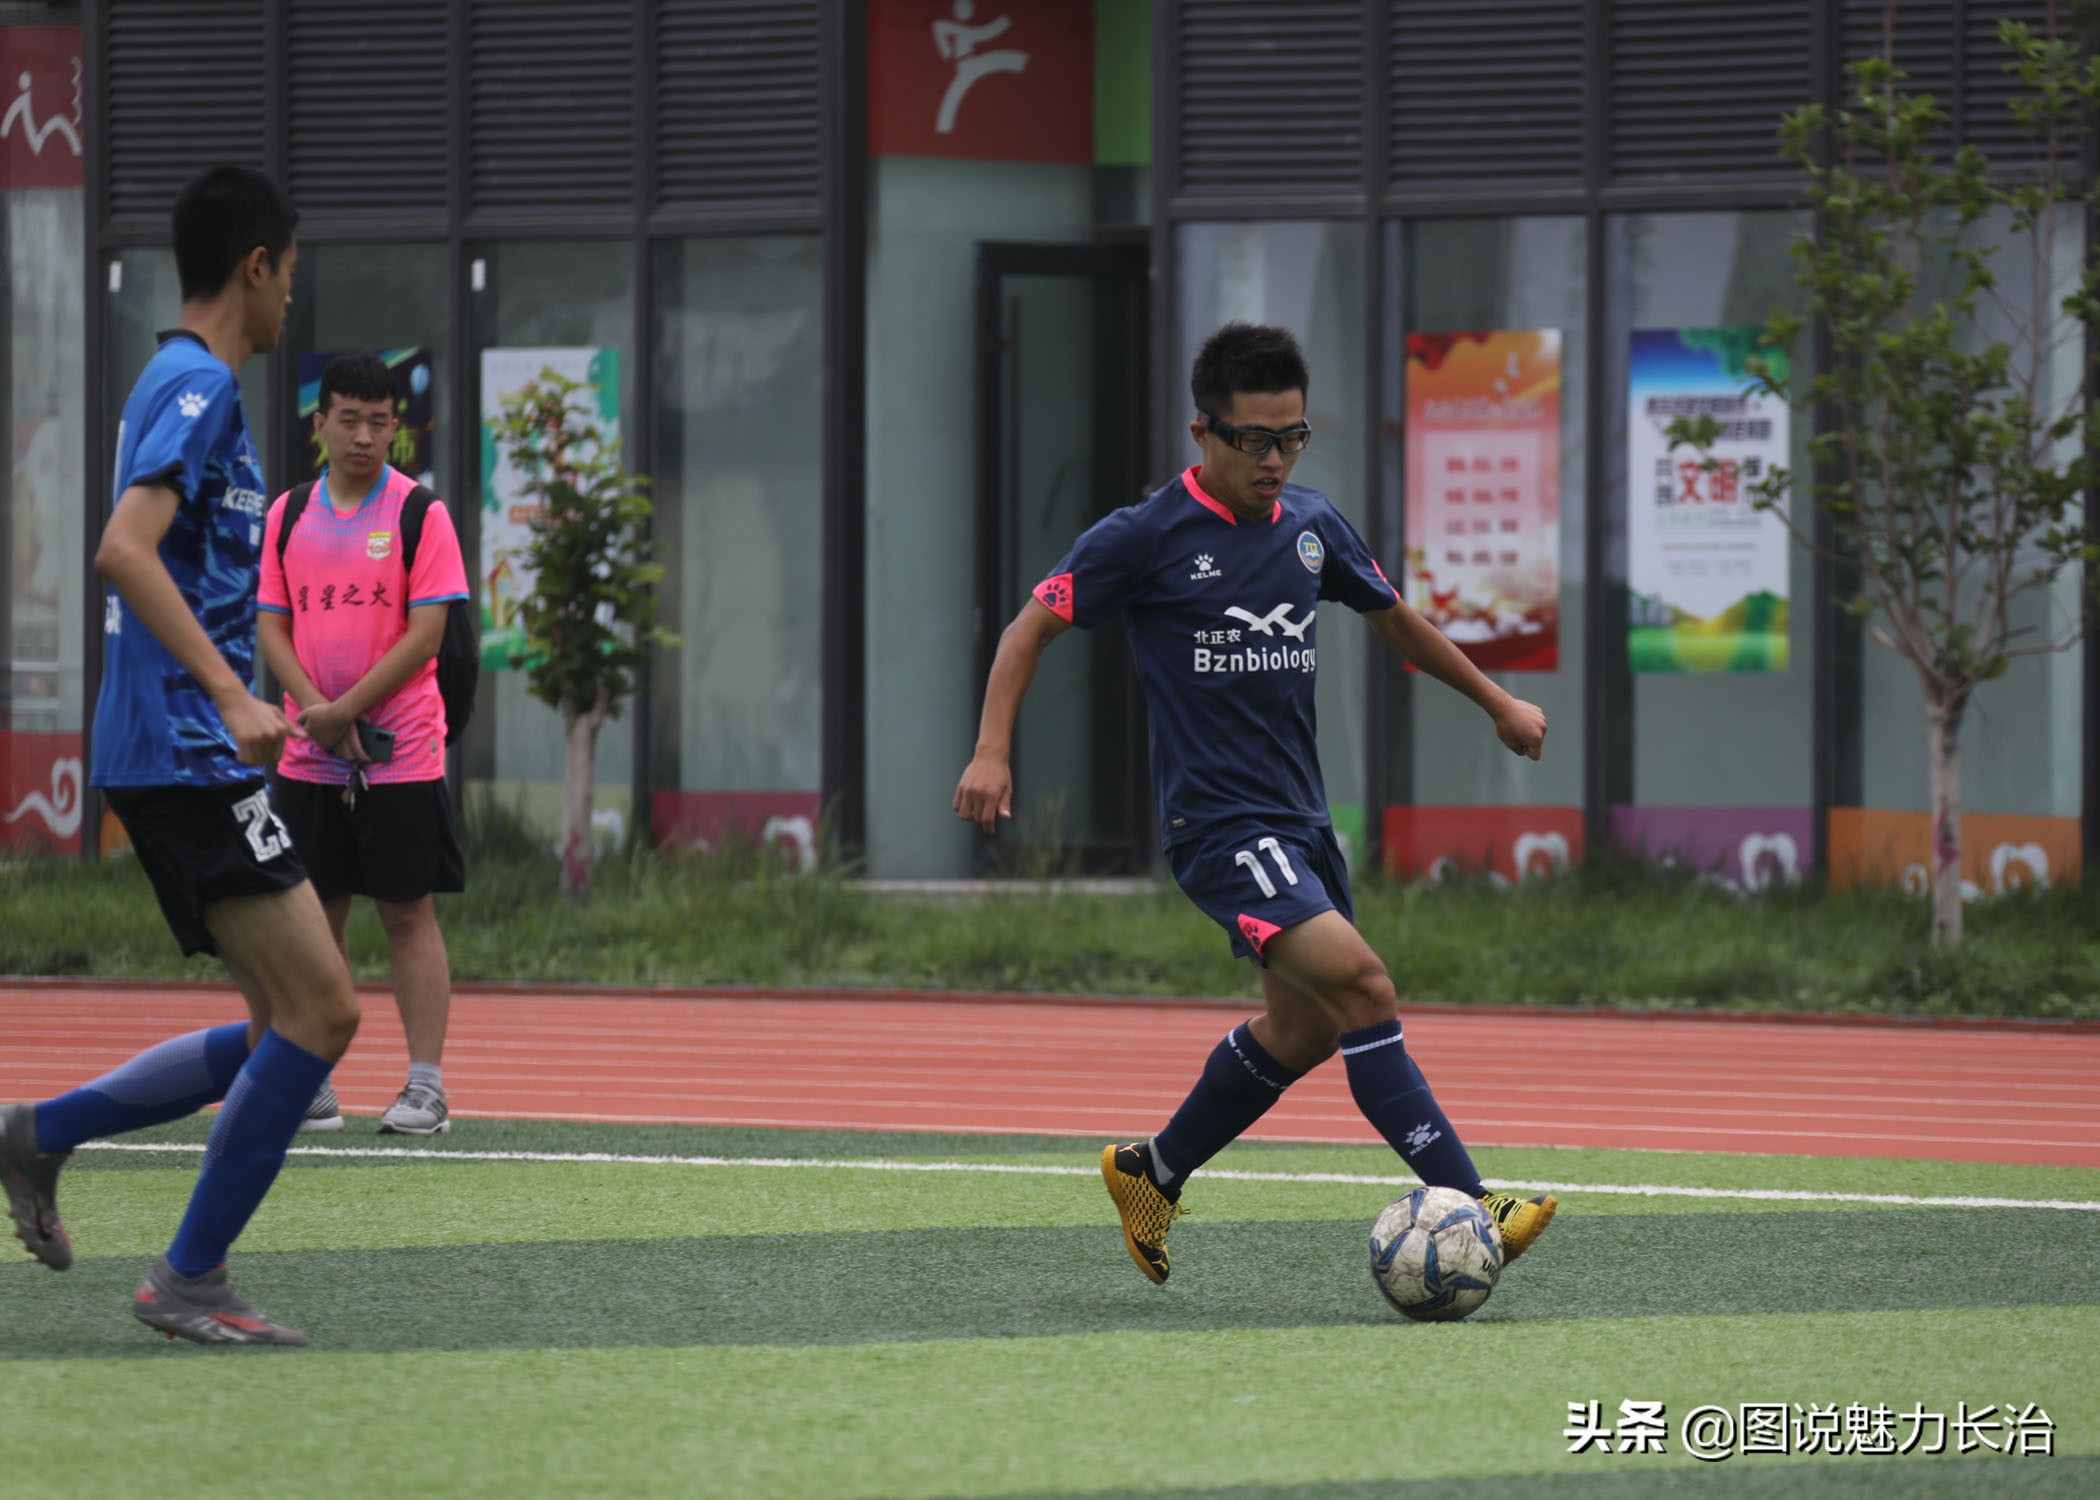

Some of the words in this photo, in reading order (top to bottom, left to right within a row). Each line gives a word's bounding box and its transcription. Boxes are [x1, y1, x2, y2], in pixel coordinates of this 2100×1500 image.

[1190, 569, 1222, 581] KELME
[298, 581, 393, 613] 星星之火
[1193, 628, 1242, 645] 北正农
[1193, 645, 1316, 673] Bznbiology
[1235, 837, 1299, 899] 11
